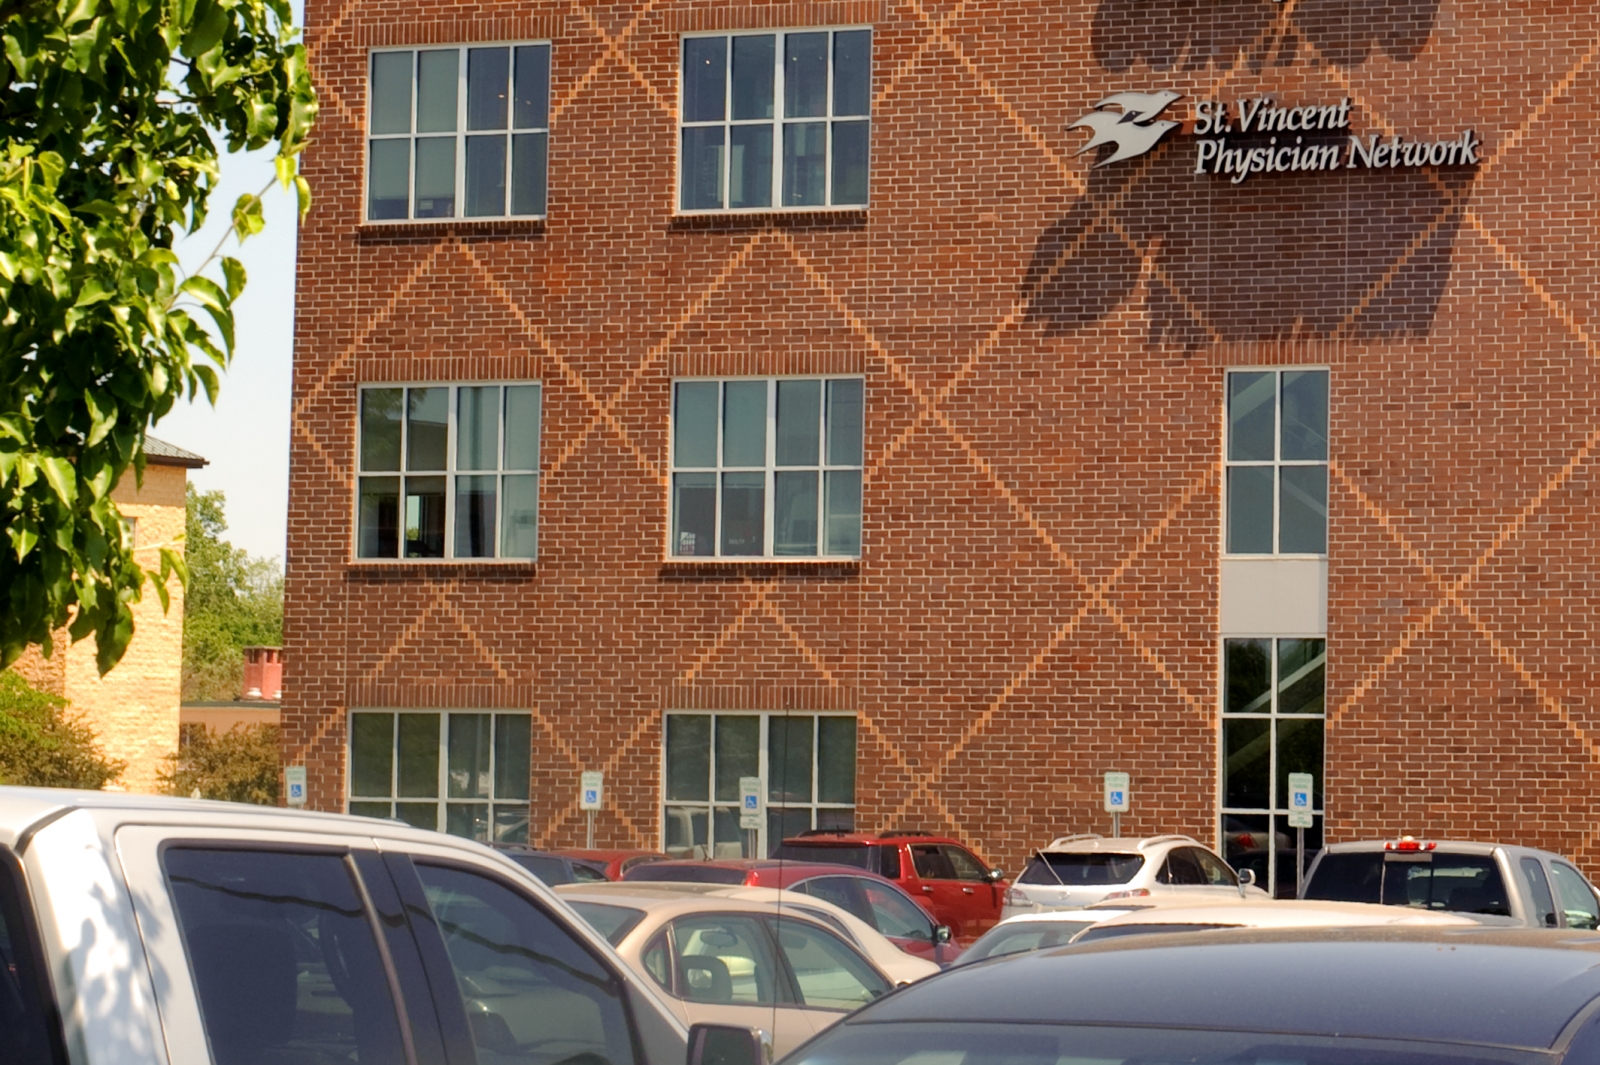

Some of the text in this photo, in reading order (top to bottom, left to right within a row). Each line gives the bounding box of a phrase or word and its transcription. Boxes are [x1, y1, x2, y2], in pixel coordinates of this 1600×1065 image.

[1194, 97, 1352, 135] St. Vincent
[1193, 130, 1482, 184] Physician Network
